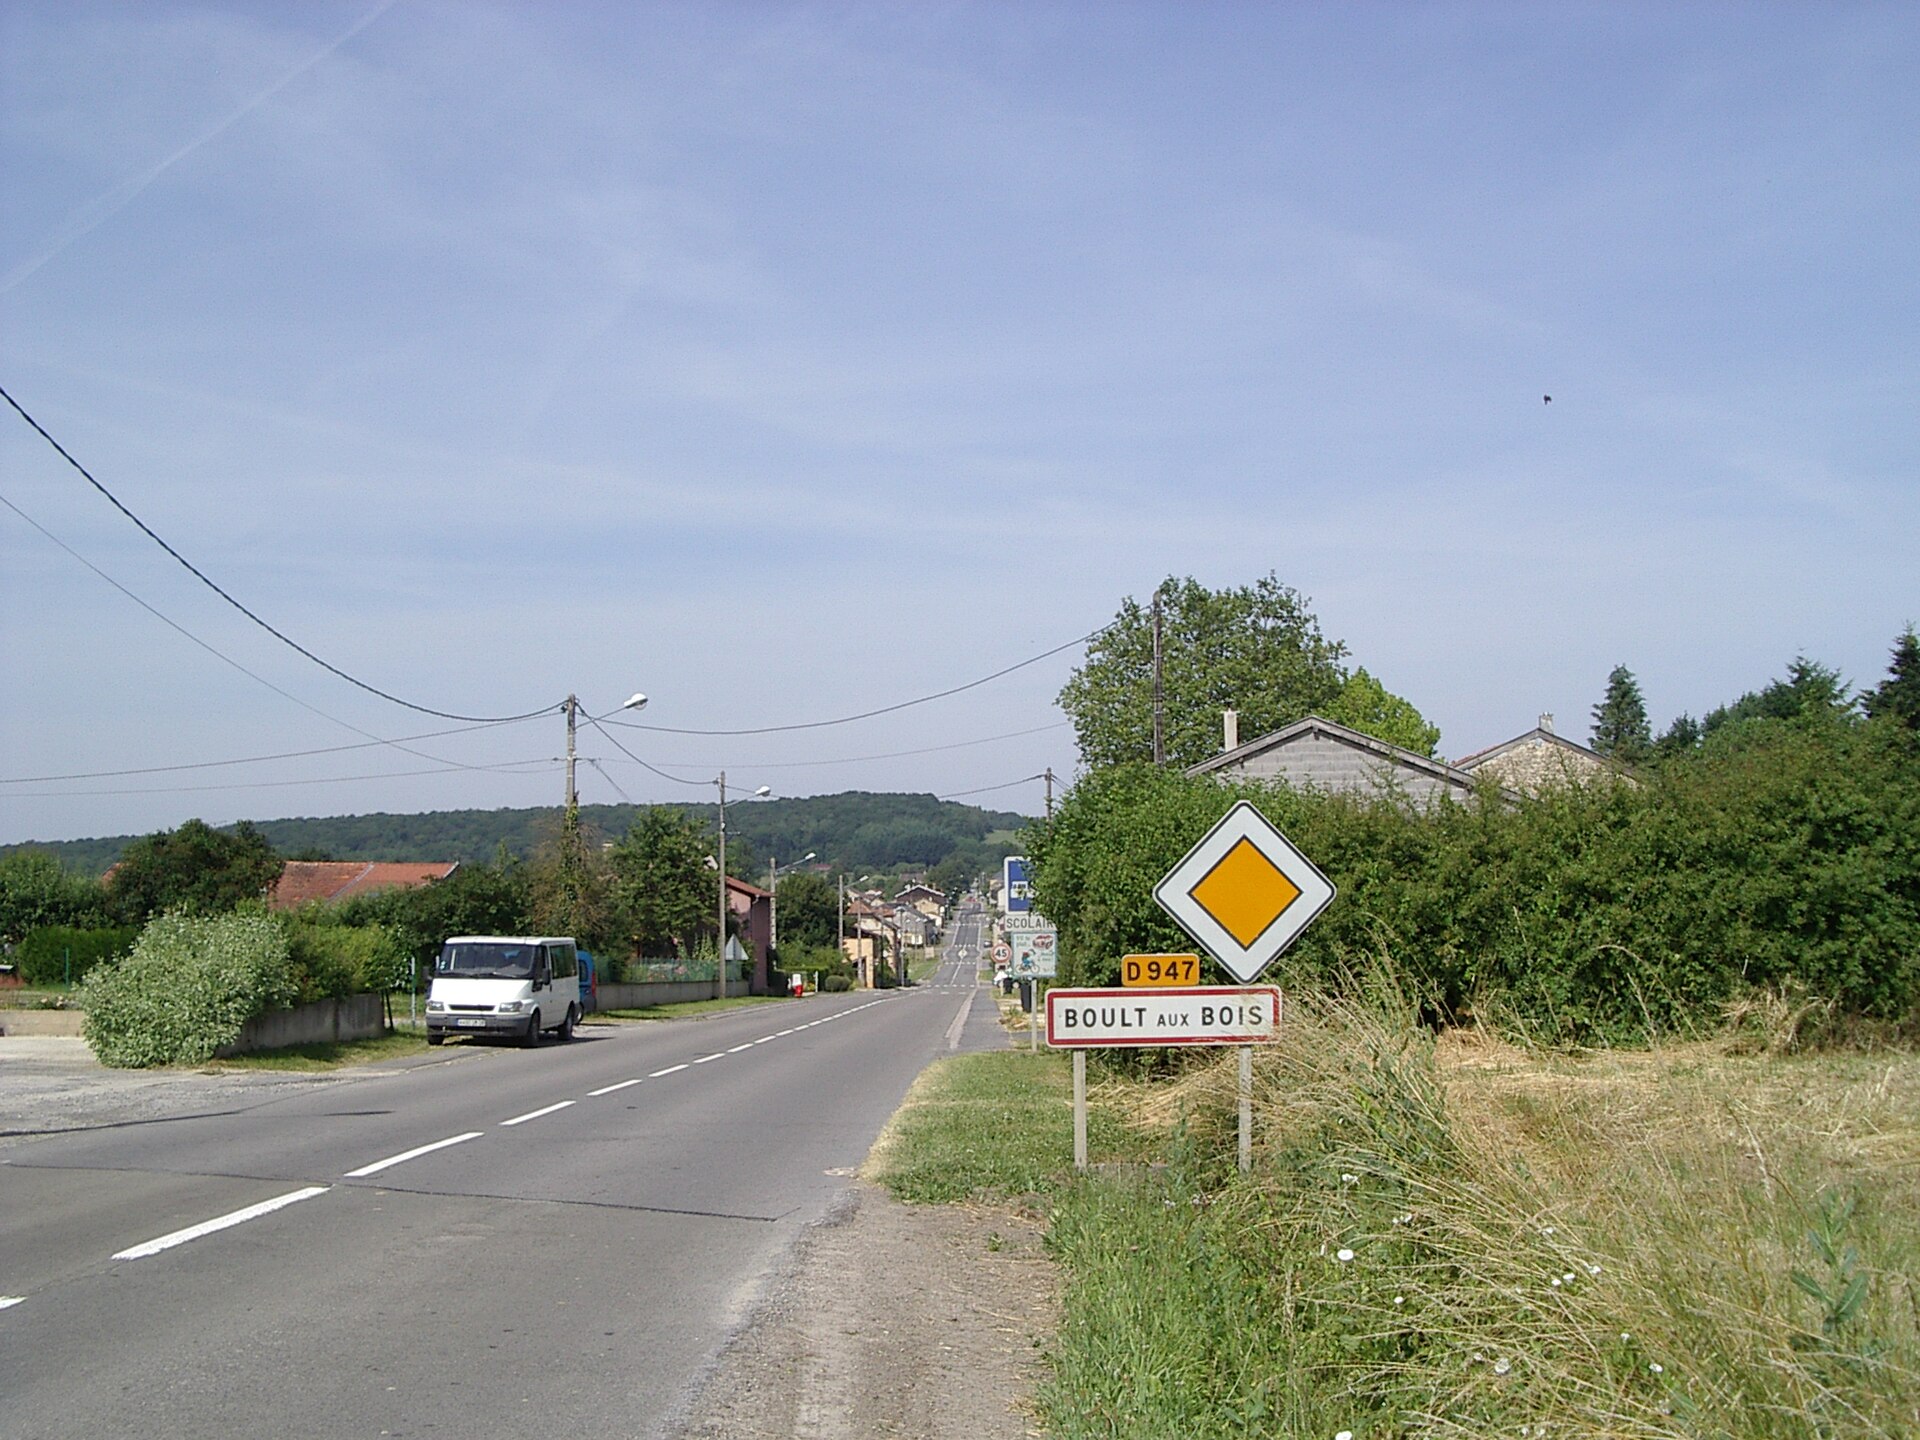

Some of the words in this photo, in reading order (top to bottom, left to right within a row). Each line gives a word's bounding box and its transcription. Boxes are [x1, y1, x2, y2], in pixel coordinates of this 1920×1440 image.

[1006, 917, 1054, 929] SCOLAIR
[995, 948, 1007, 958] 45
[1126, 963, 1141, 981] D
[1147, 961, 1195, 981] 947
[1064, 1007, 1147, 1028] BOULT
[1156, 1012, 1190, 1027] AUX
[1201, 1005, 1264, 1026] BOIS
